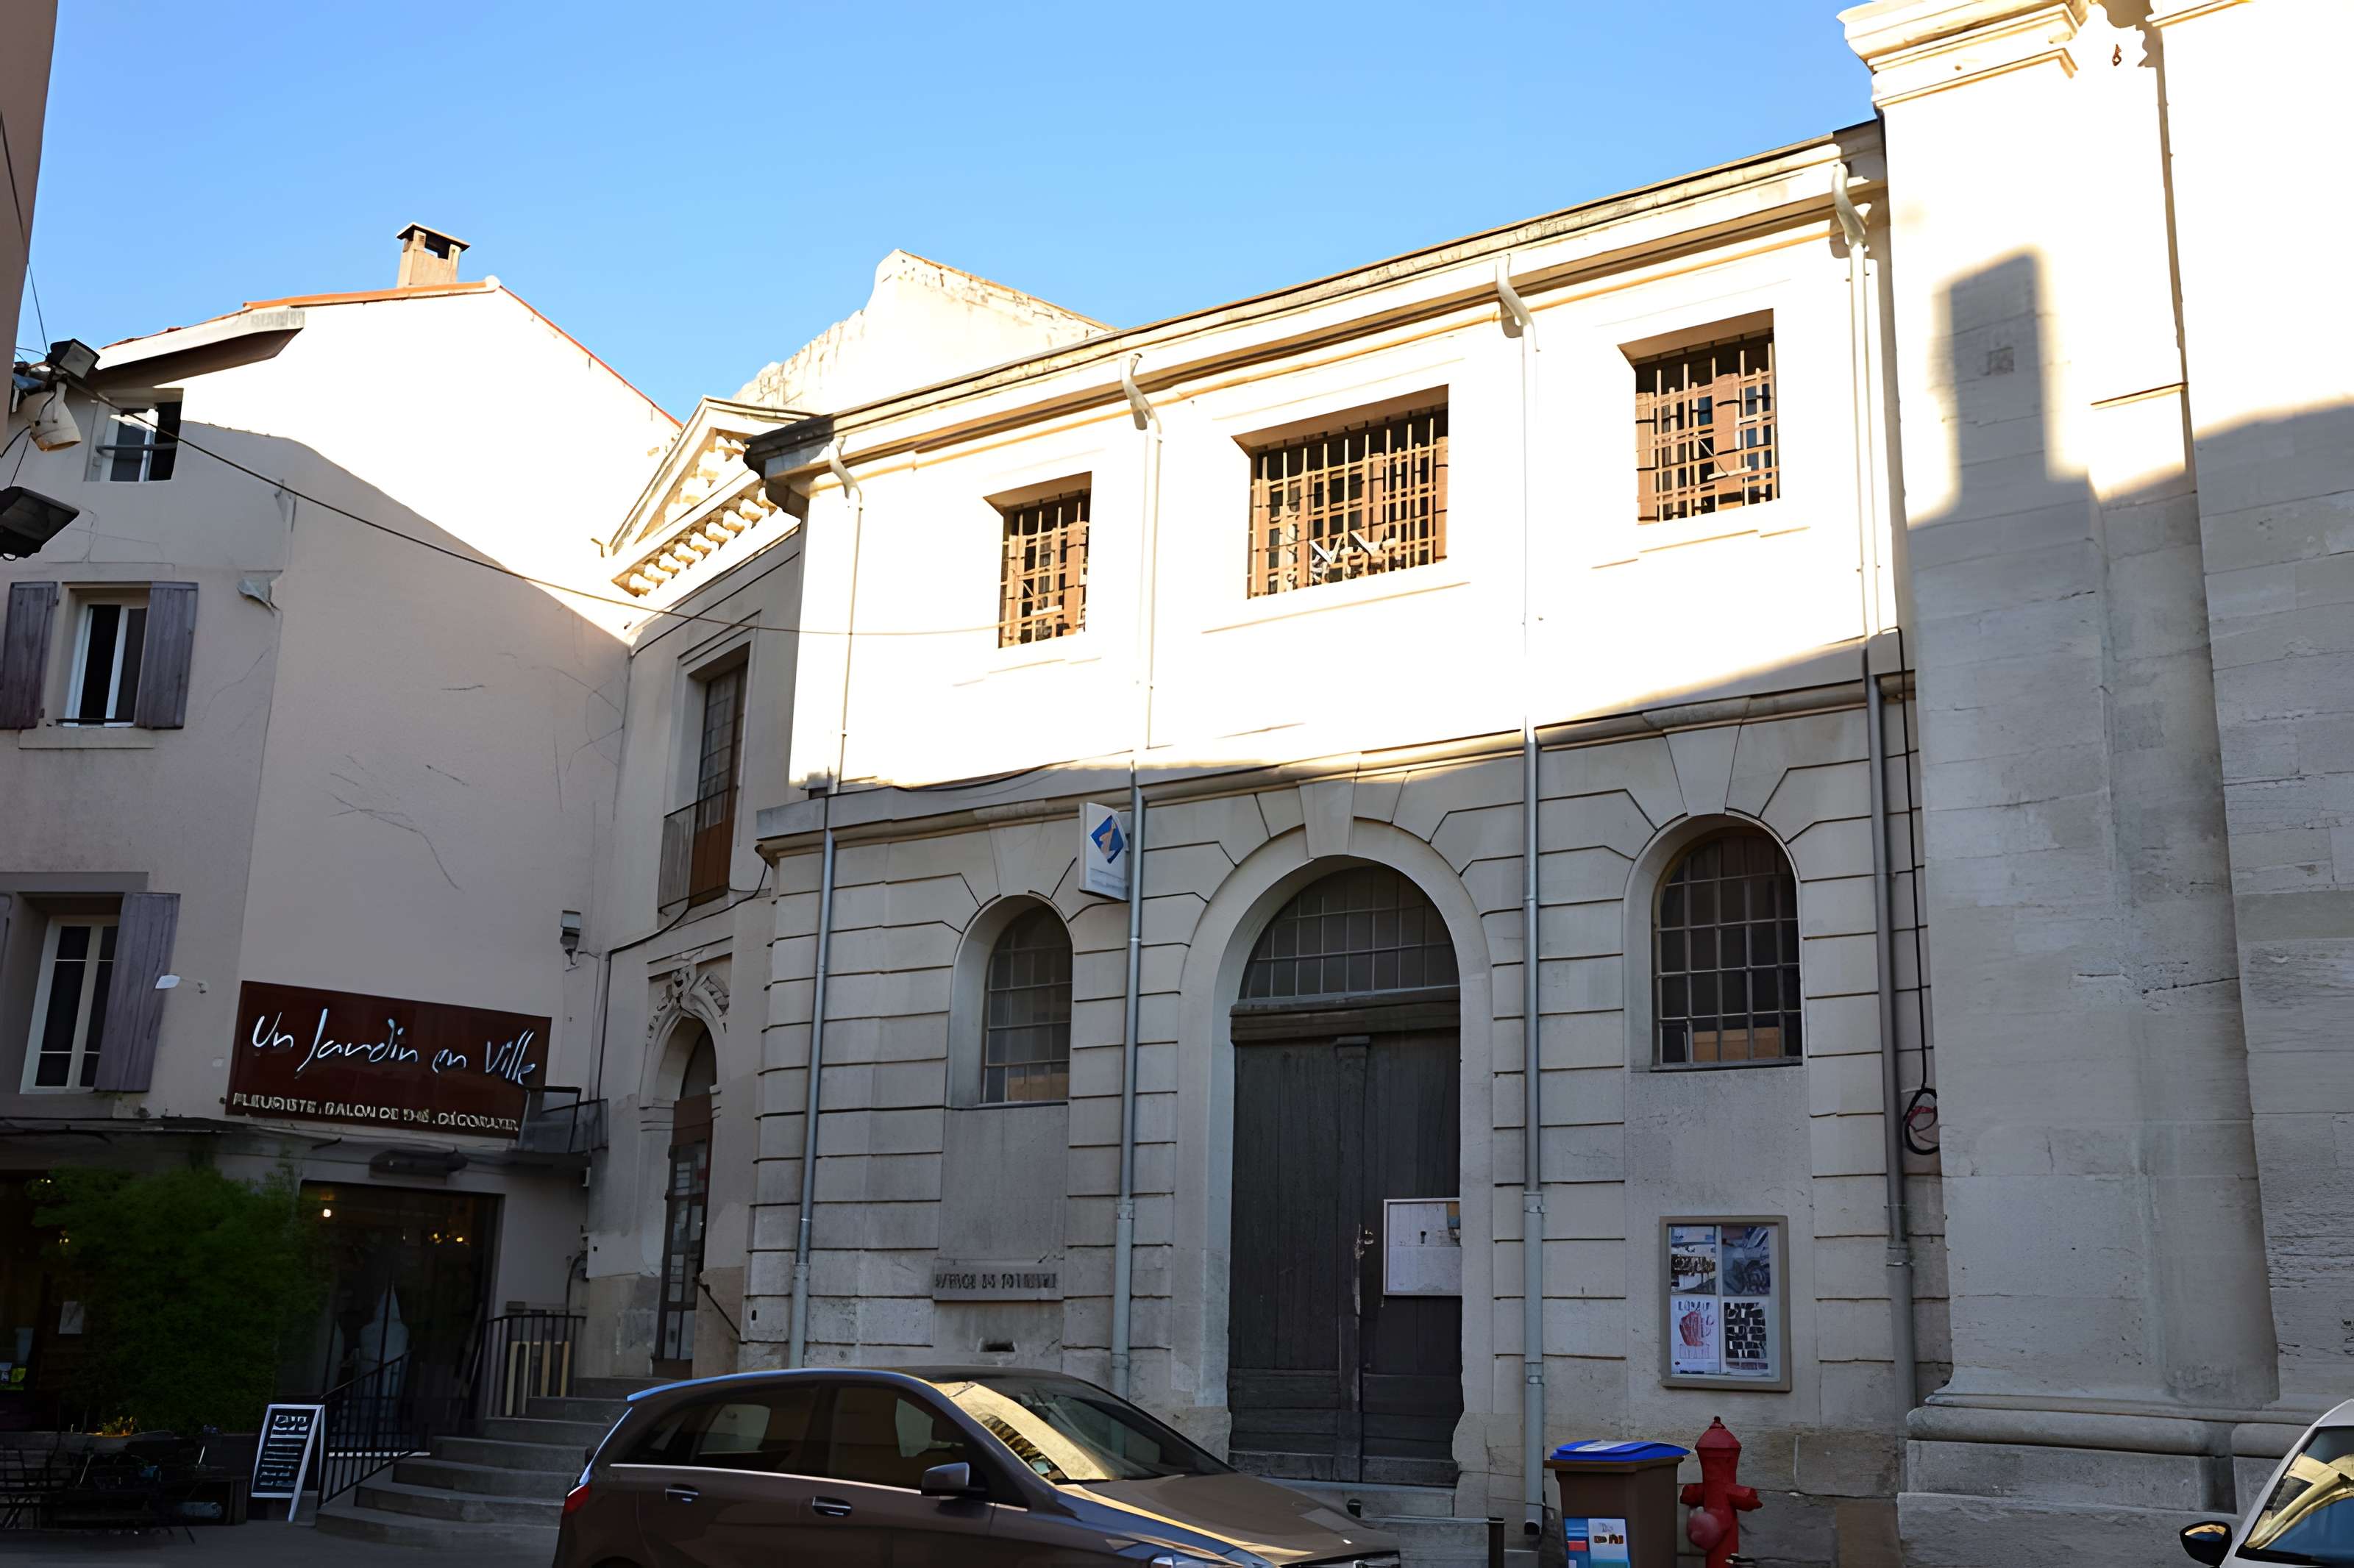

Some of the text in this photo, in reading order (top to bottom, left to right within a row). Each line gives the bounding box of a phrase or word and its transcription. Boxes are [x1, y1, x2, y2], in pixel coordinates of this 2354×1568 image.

[252, 1008, 536, 1085] Un Jardin en Ville
